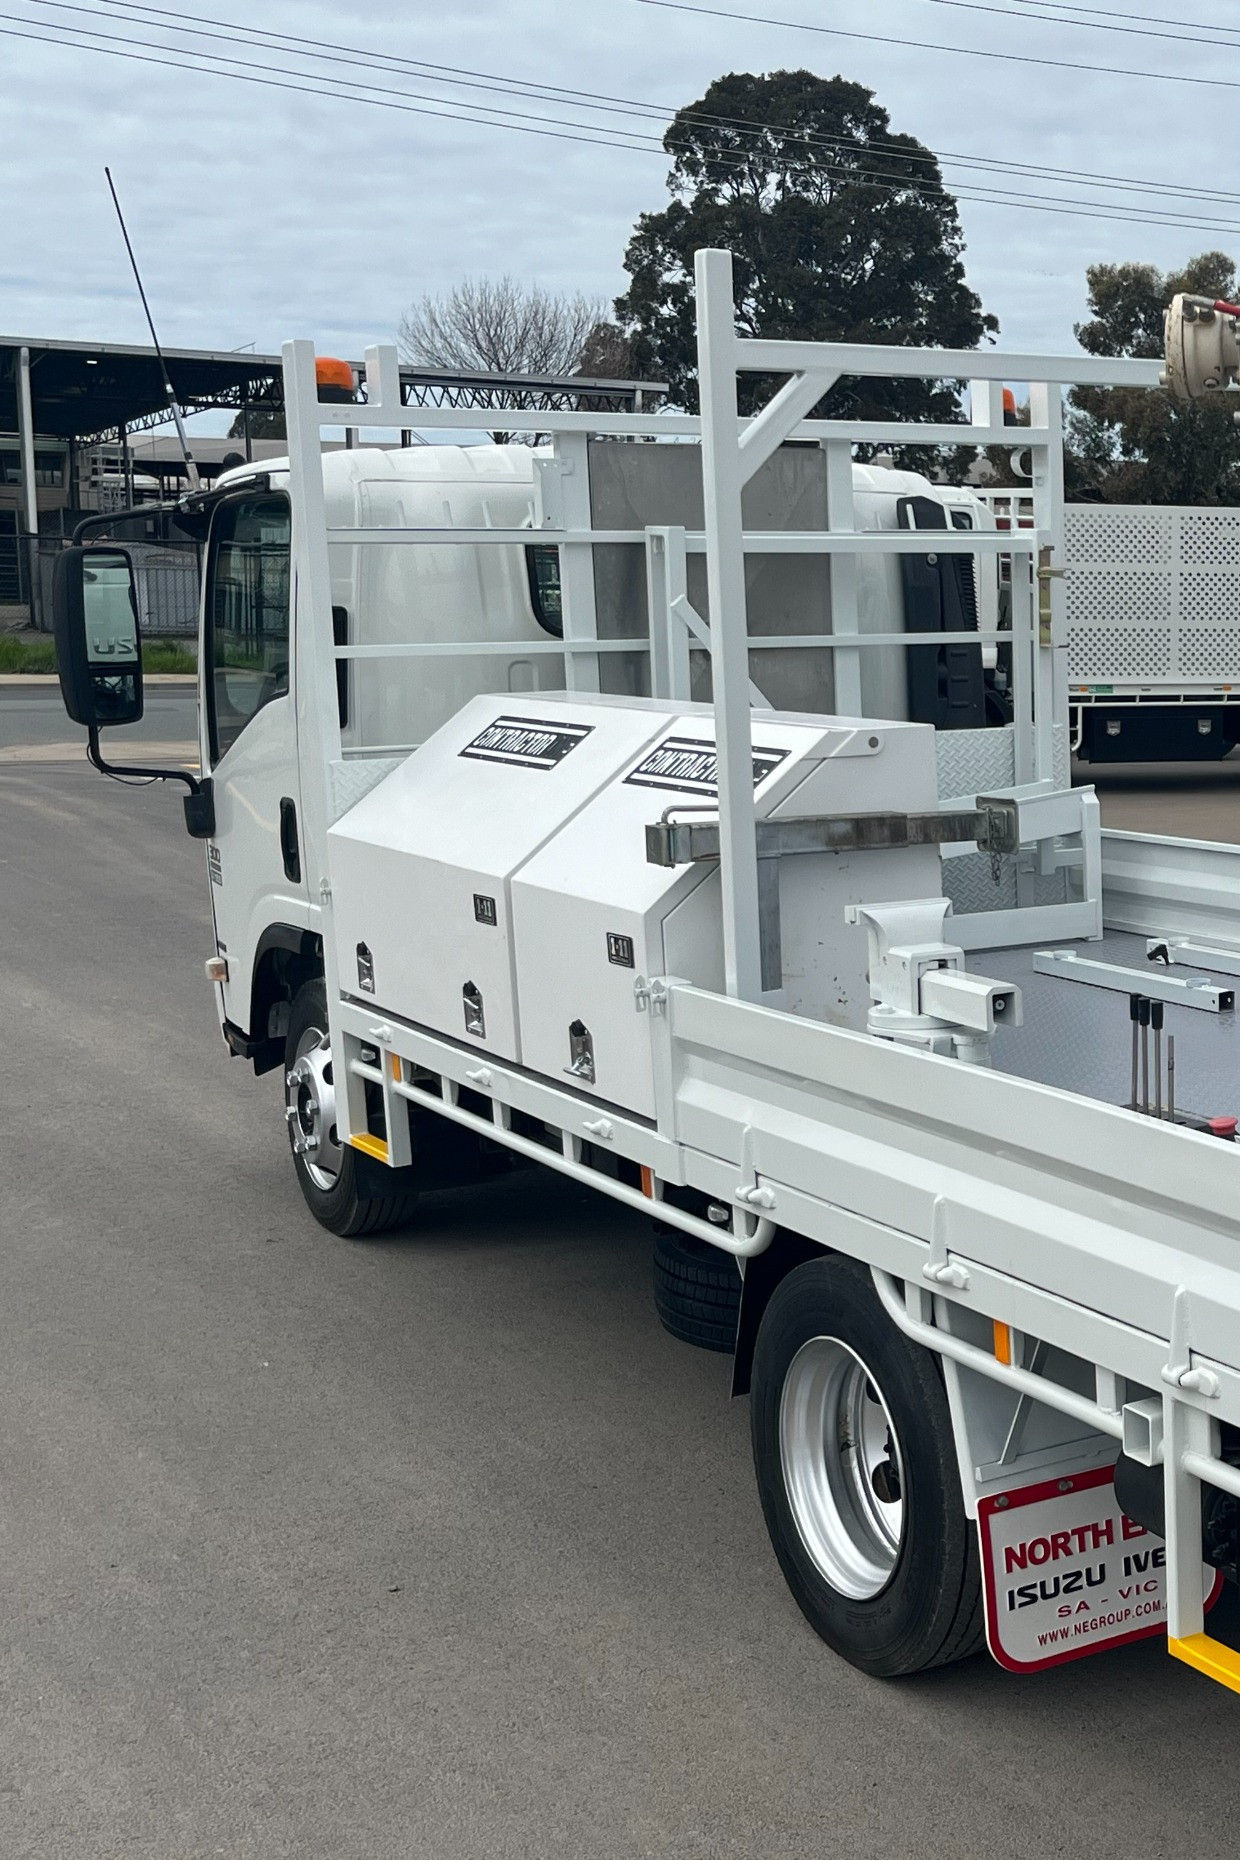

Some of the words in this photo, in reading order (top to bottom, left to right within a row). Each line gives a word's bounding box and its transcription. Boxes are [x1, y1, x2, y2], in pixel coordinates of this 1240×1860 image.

[473, 726, 558, 756] CONTRACTOR
[639, 749, 718, 781] CONTRACT
[1004, 1518, 1114, 1574] NORTH
[1008, 1563, 1106, 1611] ISUZU
[1123, 1547, 1166, 1577] IVE
[1057, 1600, 1091, 1618] SA
[1118, 1579, 1160, 1600] VIC
[1037, 1599, 1167, 1647] WWW.NEGROUP.COM.
